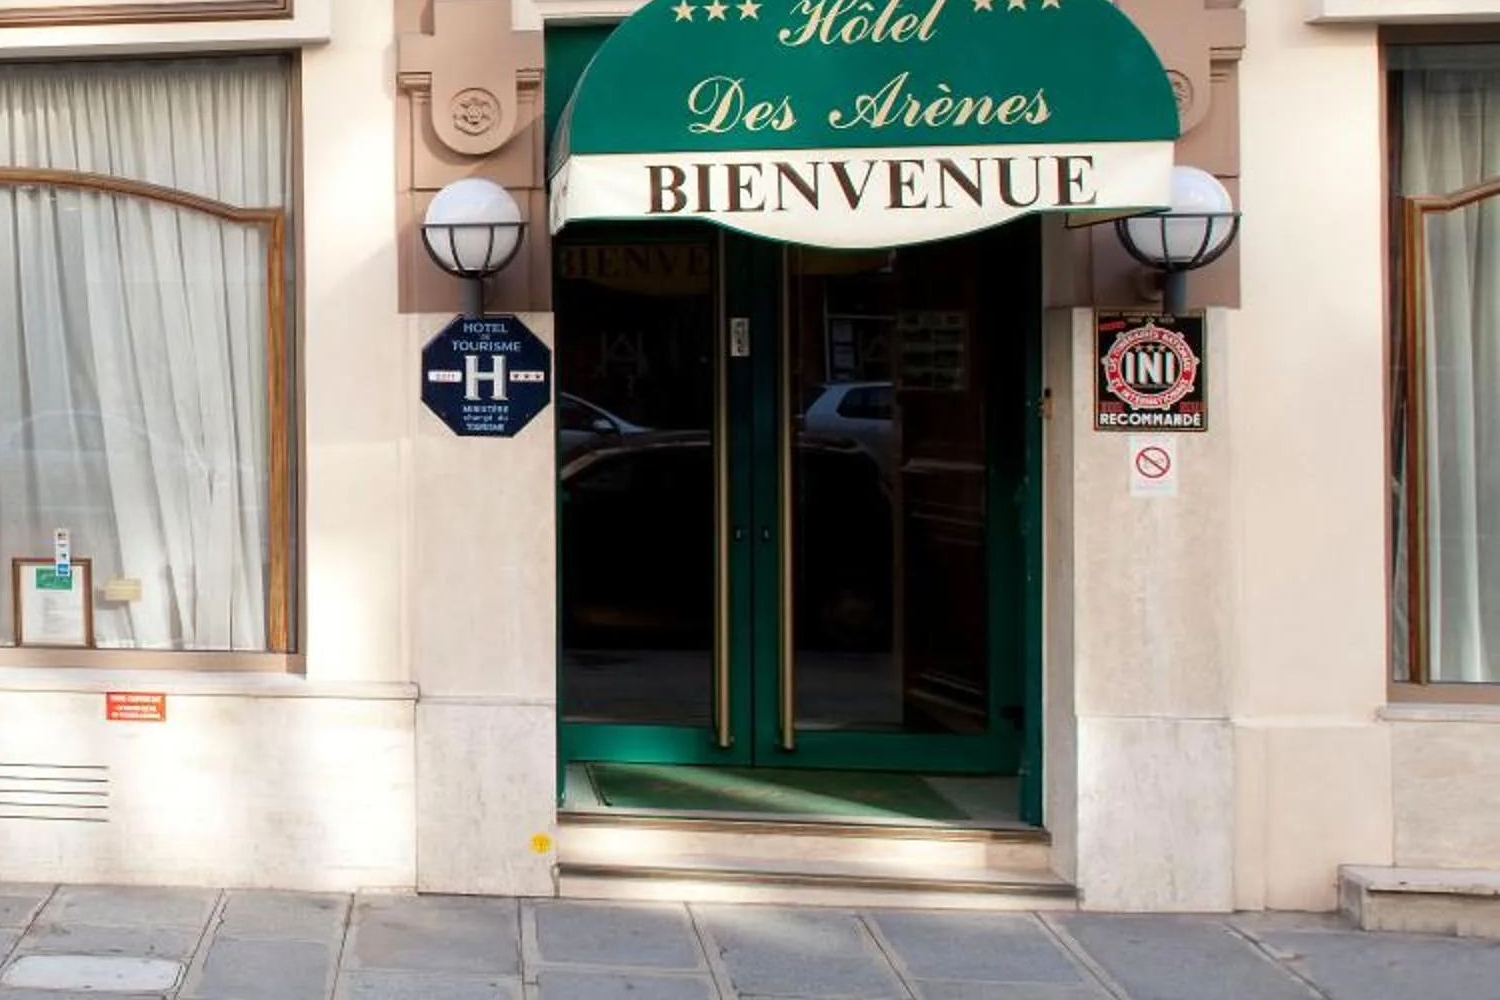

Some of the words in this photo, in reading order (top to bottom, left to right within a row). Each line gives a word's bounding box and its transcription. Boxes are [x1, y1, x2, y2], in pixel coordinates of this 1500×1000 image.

[687, 75, 797, 134] Des
[829, 71, 1054, 130] Arènes
[644, 154, 1099, 215] BIENVENUE
[452, 341, 521, 352] TOURISME
[1125, 351, 1175, 385] INI
[463, 355, 509, 401] H
